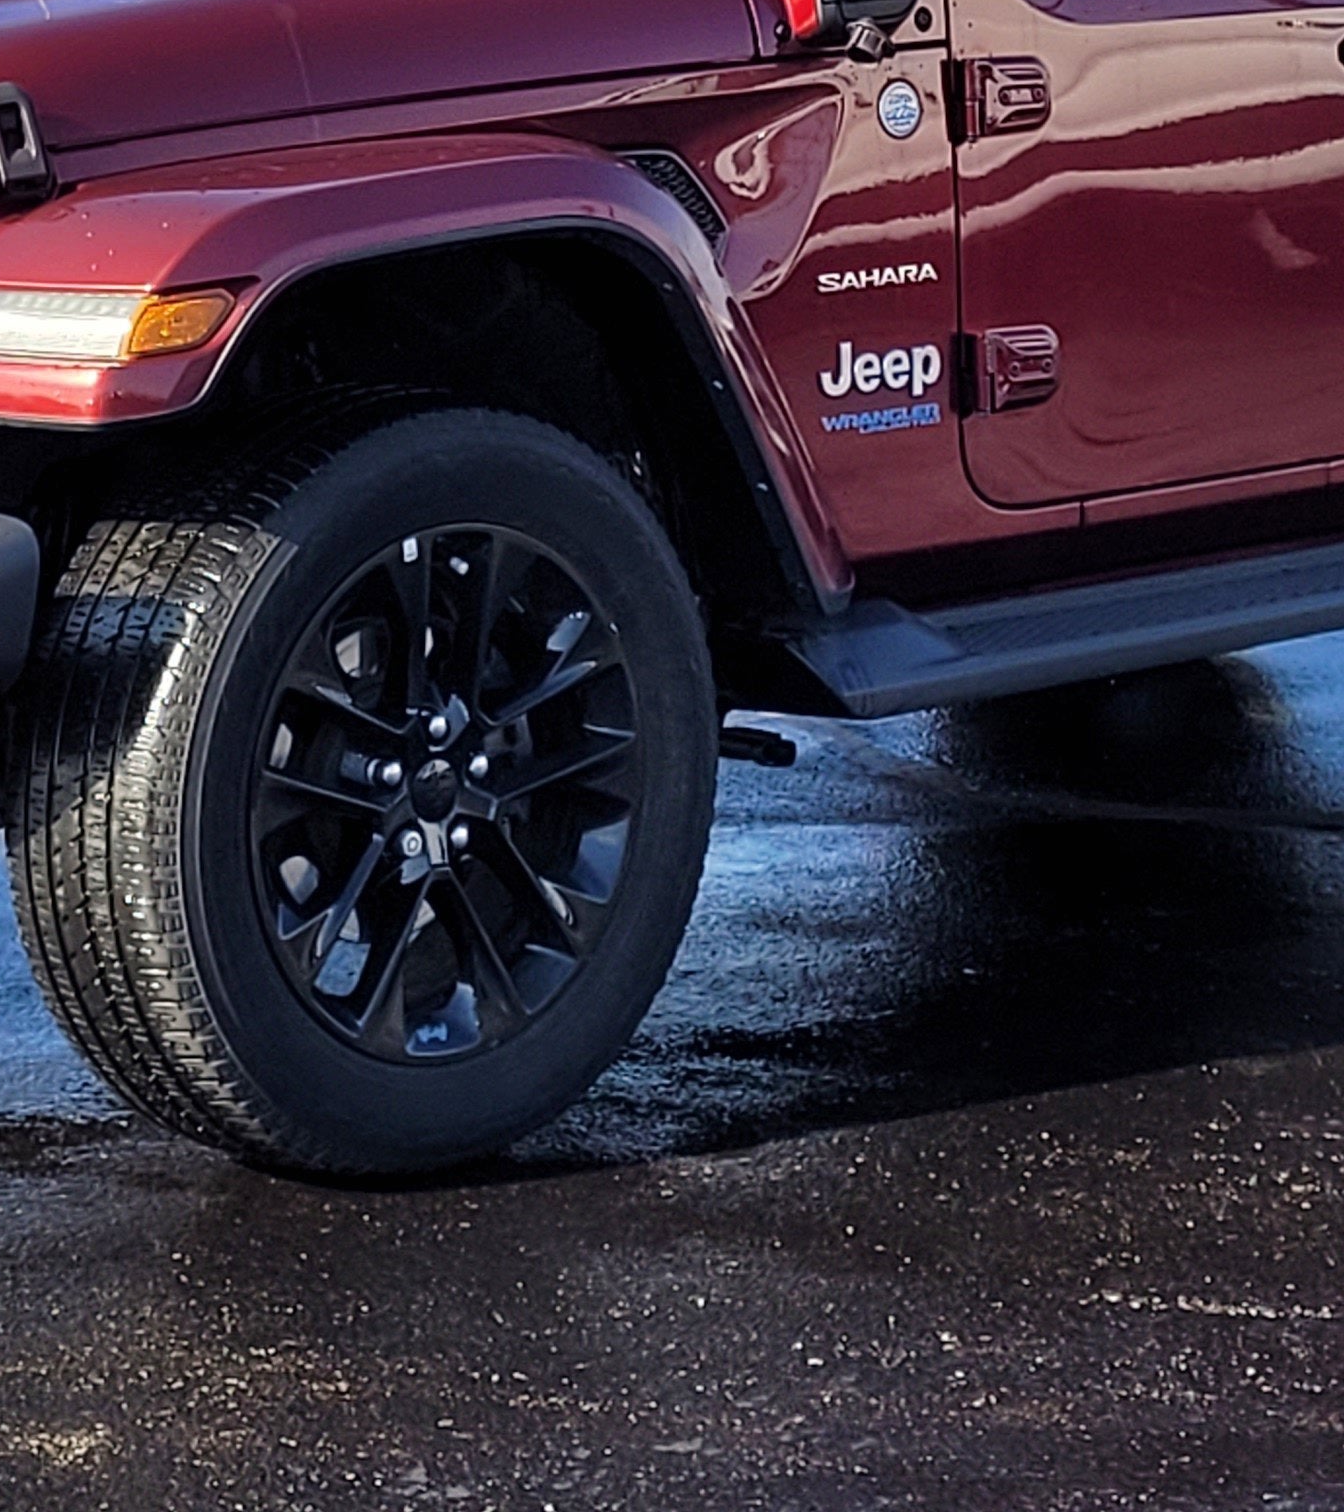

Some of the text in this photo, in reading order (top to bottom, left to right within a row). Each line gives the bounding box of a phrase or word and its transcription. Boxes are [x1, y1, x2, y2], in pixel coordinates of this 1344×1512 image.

[817, 263, 938, 293] SAHARA
[819, 341, 942, 397] Jeep
[820, 402, 940, 431] WRANGLER
